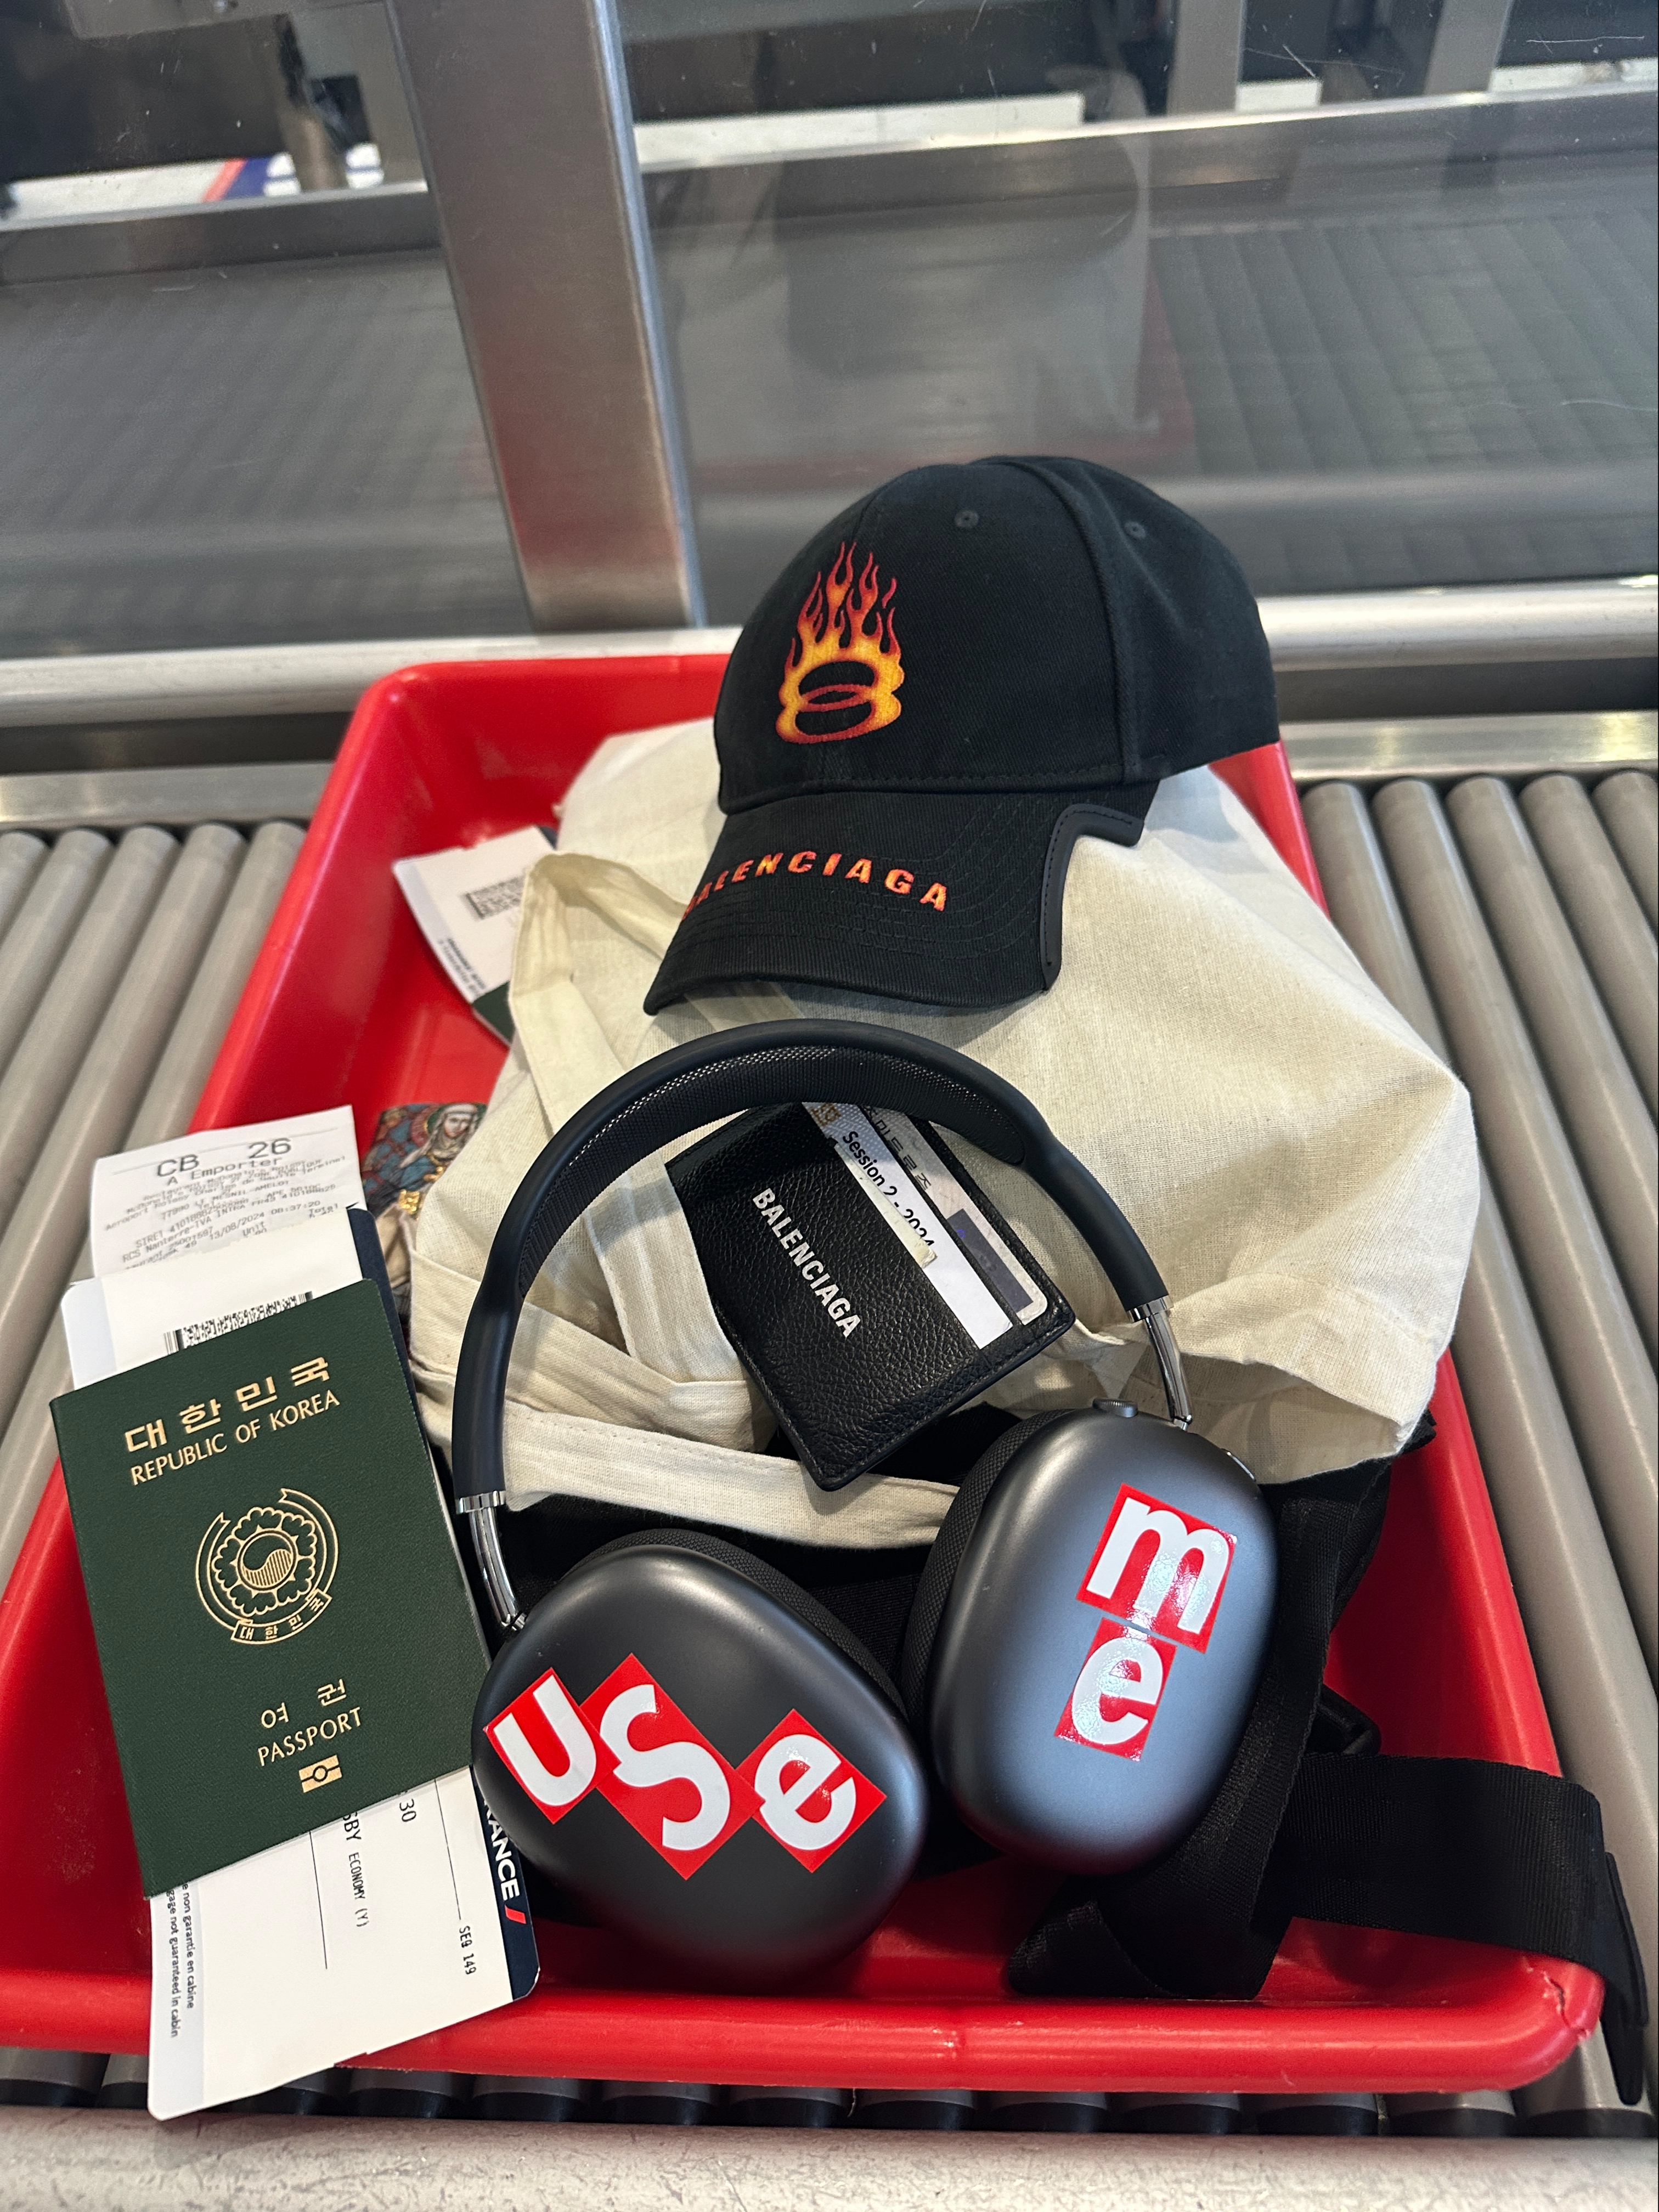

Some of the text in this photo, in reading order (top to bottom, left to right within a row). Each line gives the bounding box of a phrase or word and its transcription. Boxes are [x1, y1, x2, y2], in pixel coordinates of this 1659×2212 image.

[157, 1137, 291, 1177] CB 26
[167, 1156, 283, 1186] A Emporter
[843, 1131, 885, 1187] Session
[884, 1186, 898, 1195] 2
[210, 1212, 265, 1240] 13/08/2024
[272, 1200, 320, 1215] 08:37:20
[122, 1250, 141, 1263] RCS
[753, 1188, 862, 1337] BALENCIAGA
[131, 1390, 340, 1486] REPUBLIC OF KOREA
[257, 1707, 362, 1766] PASSPORT
[348, 1852, 366, 1900] ECONOMY
[170, 1916, 179, 1935] not
[355, 1908, 370, 1927] (Y)
[183, 1915, 196, 1958] garantie
[169, 1937, 182, 1995] guaranteed
[187, 1960, 194, 1974] en
[463, 1953, 476, 1975] 149
[172, 1995, 181, 2007] in
[187, 1976, 198, 2008] cabine
[171, 2008, 182, 2038] cabin
